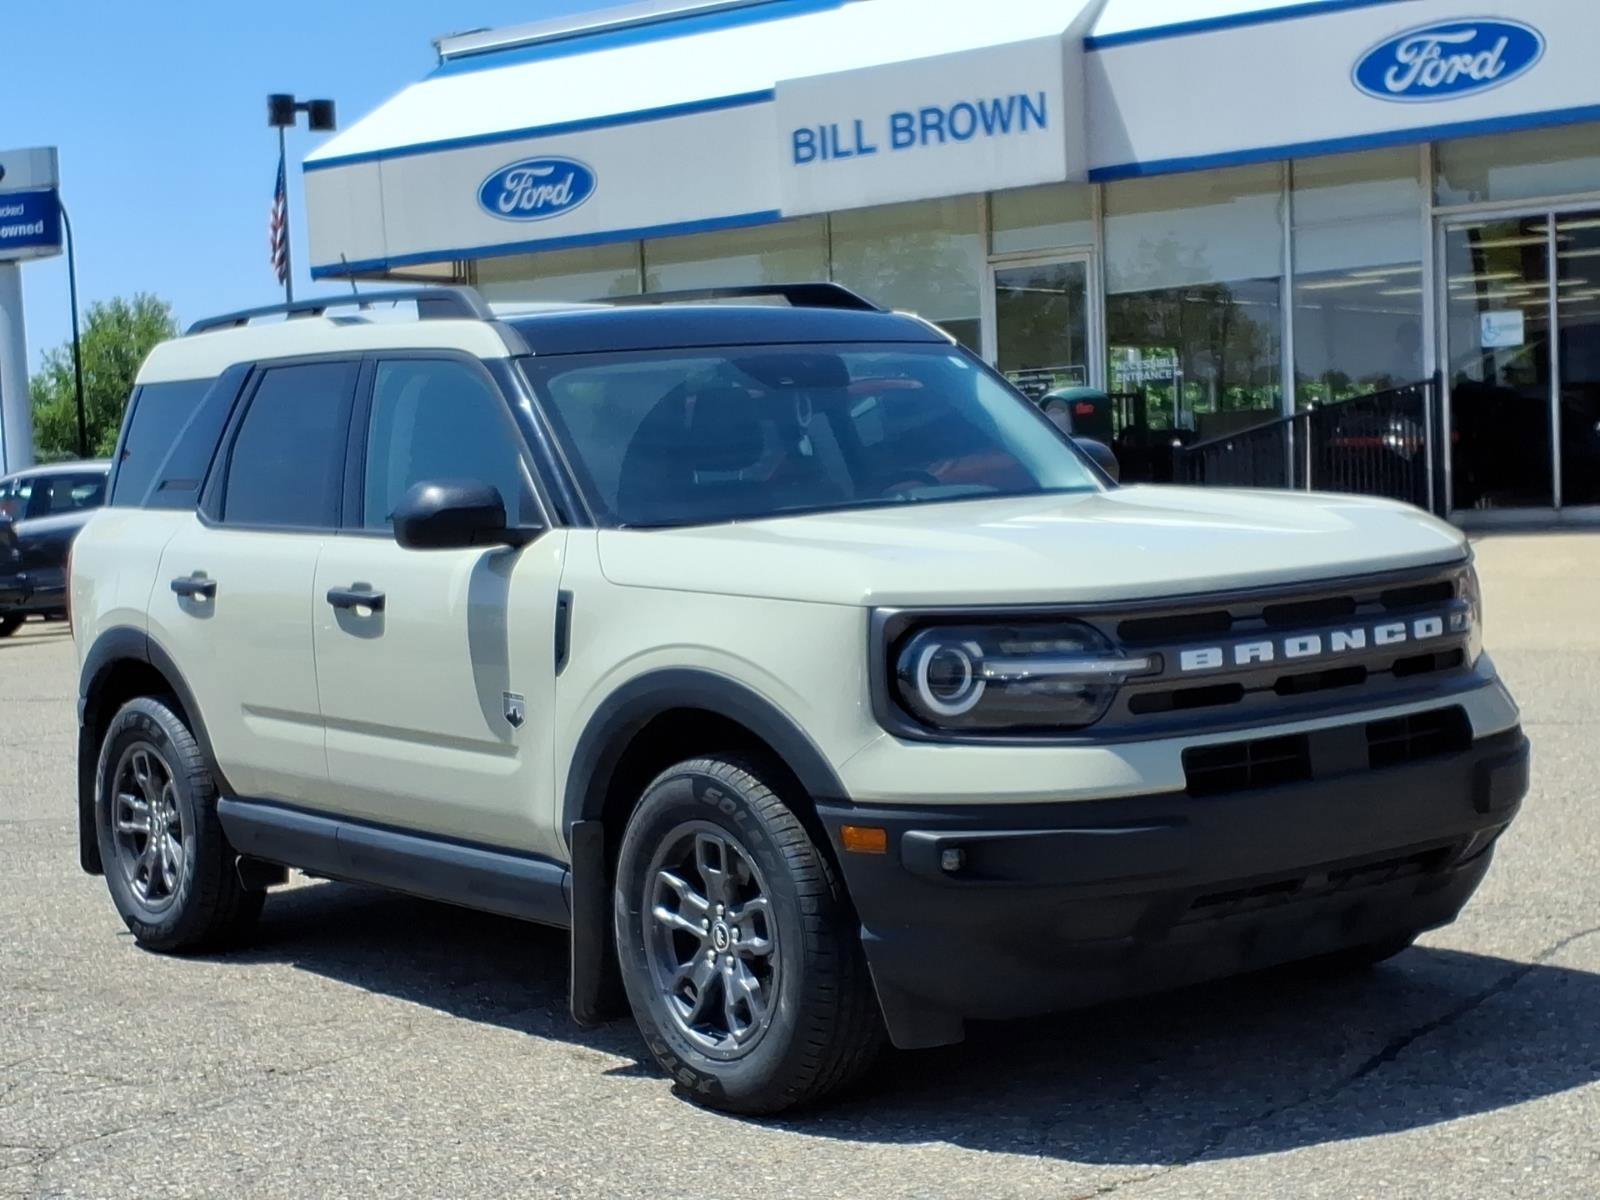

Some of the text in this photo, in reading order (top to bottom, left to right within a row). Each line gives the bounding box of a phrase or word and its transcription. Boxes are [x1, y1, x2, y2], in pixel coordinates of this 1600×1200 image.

[1384, 29, 1509, 92] Ford
[792, 91, 1047, 165] BILL BROWN
[499, 166, 575, 213] Ford
[1116, 356, 1179, 371] ACCESSIBLE
[1116, 370, 1172, 383] ENTRANCE
[1180, 617, 1442, 671] BRONCO
